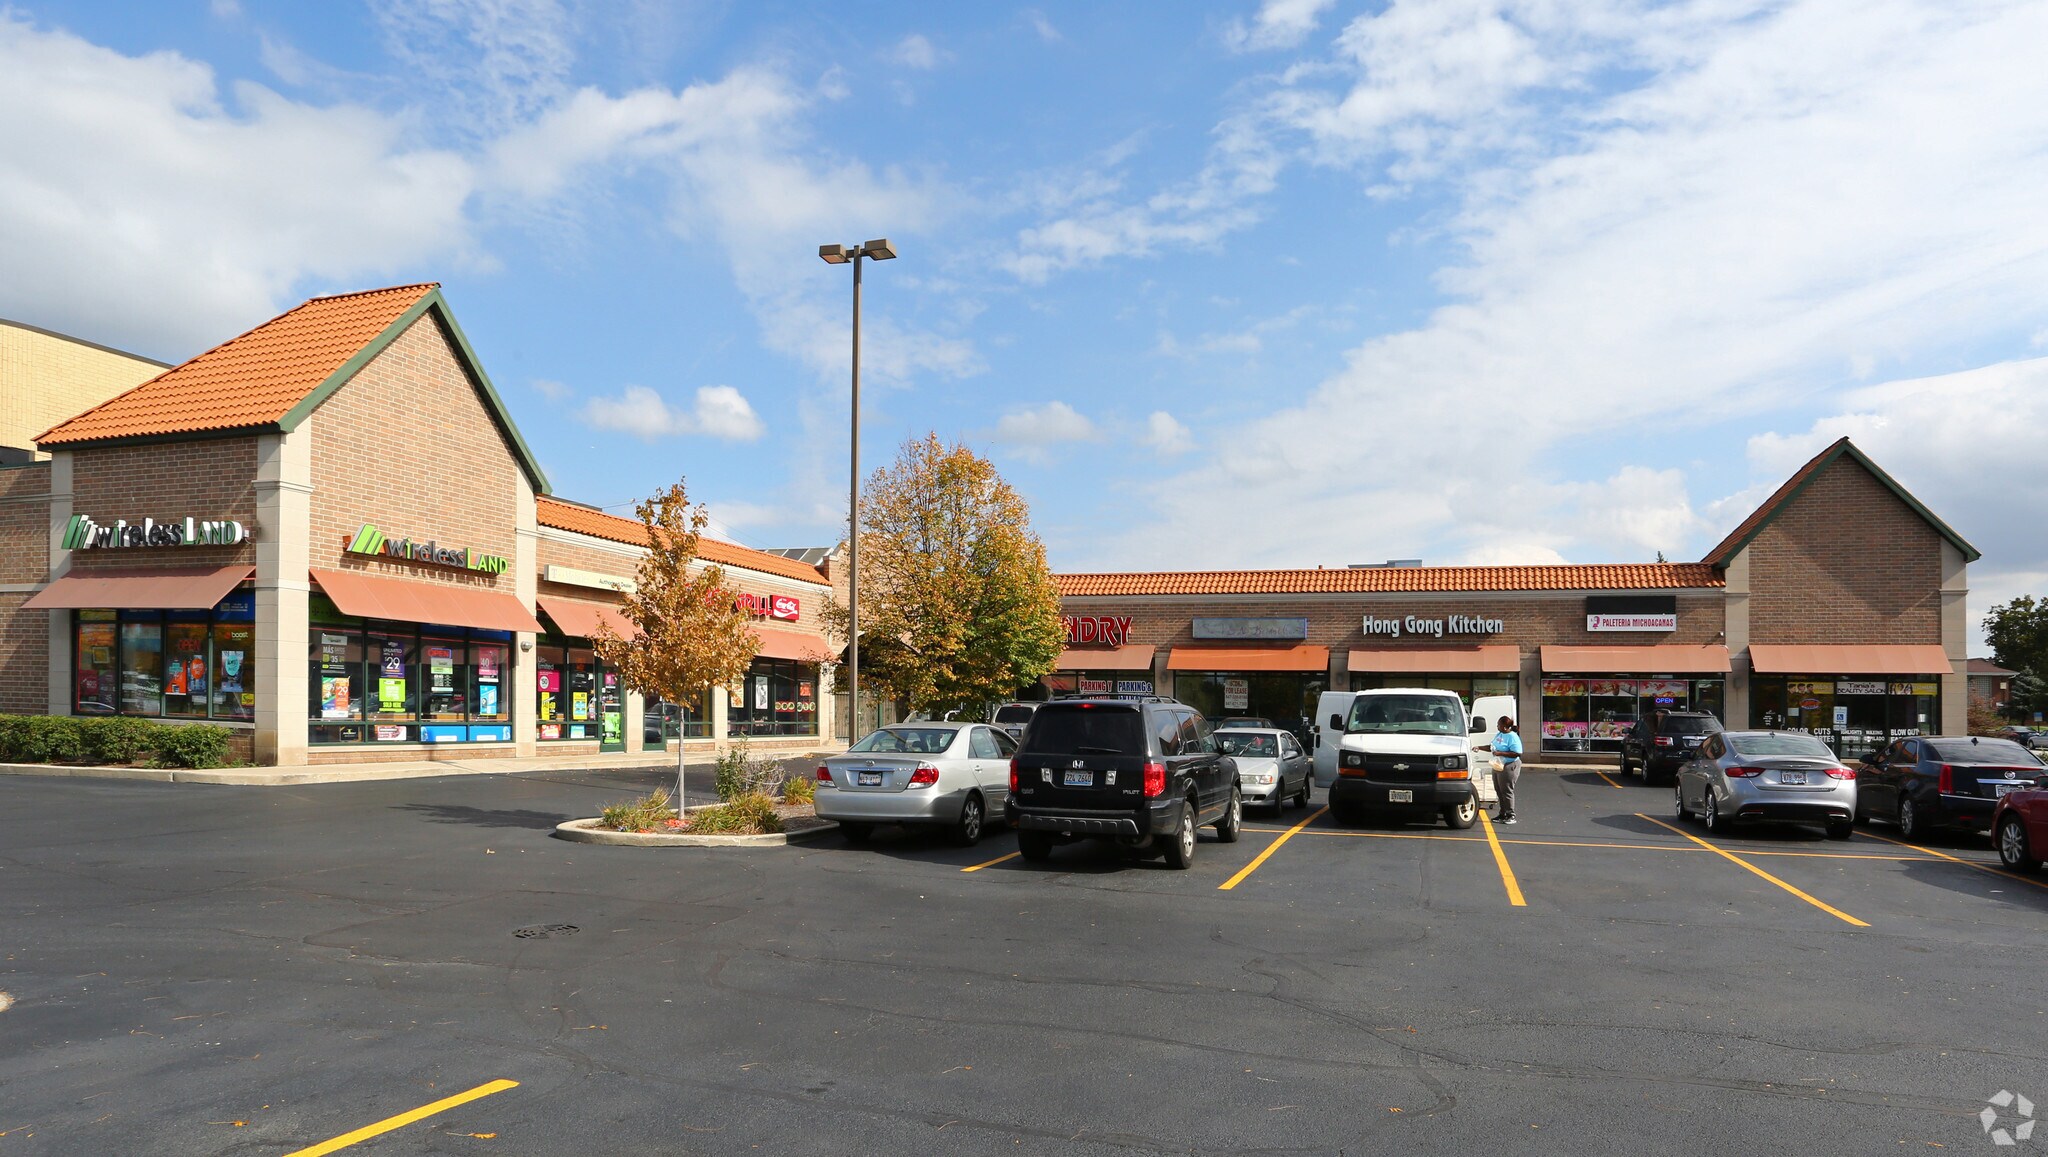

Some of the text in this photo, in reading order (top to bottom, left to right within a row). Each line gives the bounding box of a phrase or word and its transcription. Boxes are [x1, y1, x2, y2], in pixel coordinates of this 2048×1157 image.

[1363, 615, 1504, 638] Hong Gong Kitchen
[1602, 618, 1674, 627] PALETERIA MICHOACANAS
[231, 631, 249, 639] boost
[1061, 616, 1133, 646] NDRY
[1080, 680, 1113, 692] PARKING Y
[1118, 680, 1152, 692] PARKING &
[1225, 687, 1248, 695] FOR LEASE
[1813, 727, 1831, 735] CUTS
[1890, 728, 1920, 736] BLOW OUT
